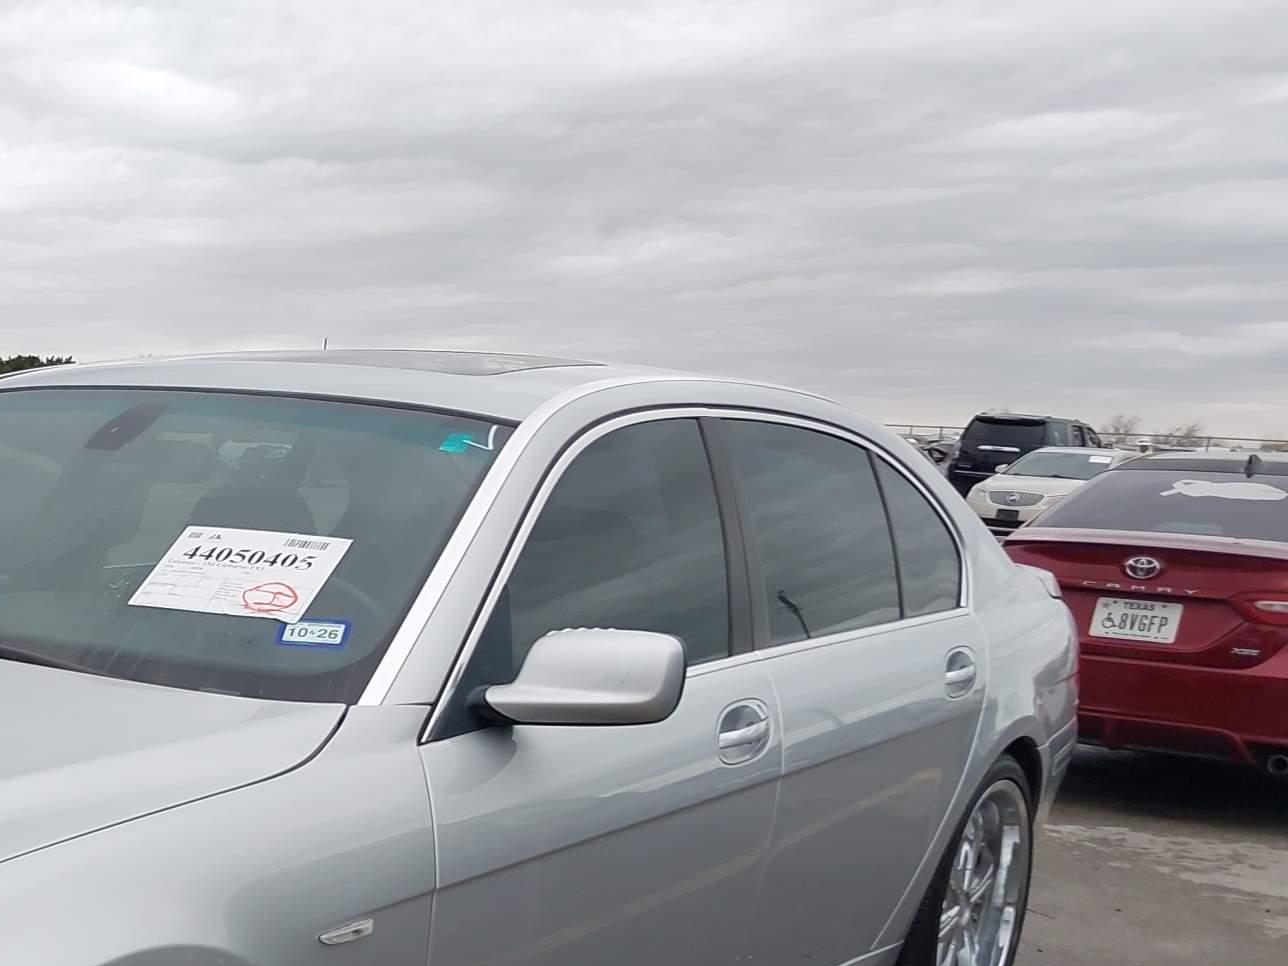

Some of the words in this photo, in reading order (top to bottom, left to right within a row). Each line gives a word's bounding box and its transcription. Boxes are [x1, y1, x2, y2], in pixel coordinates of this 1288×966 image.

[183, 545, 318, 571] 44050405
[1123, 601, 1155, 611] TEXAS
[1118, 612, 1168, 633] 8VGFP
